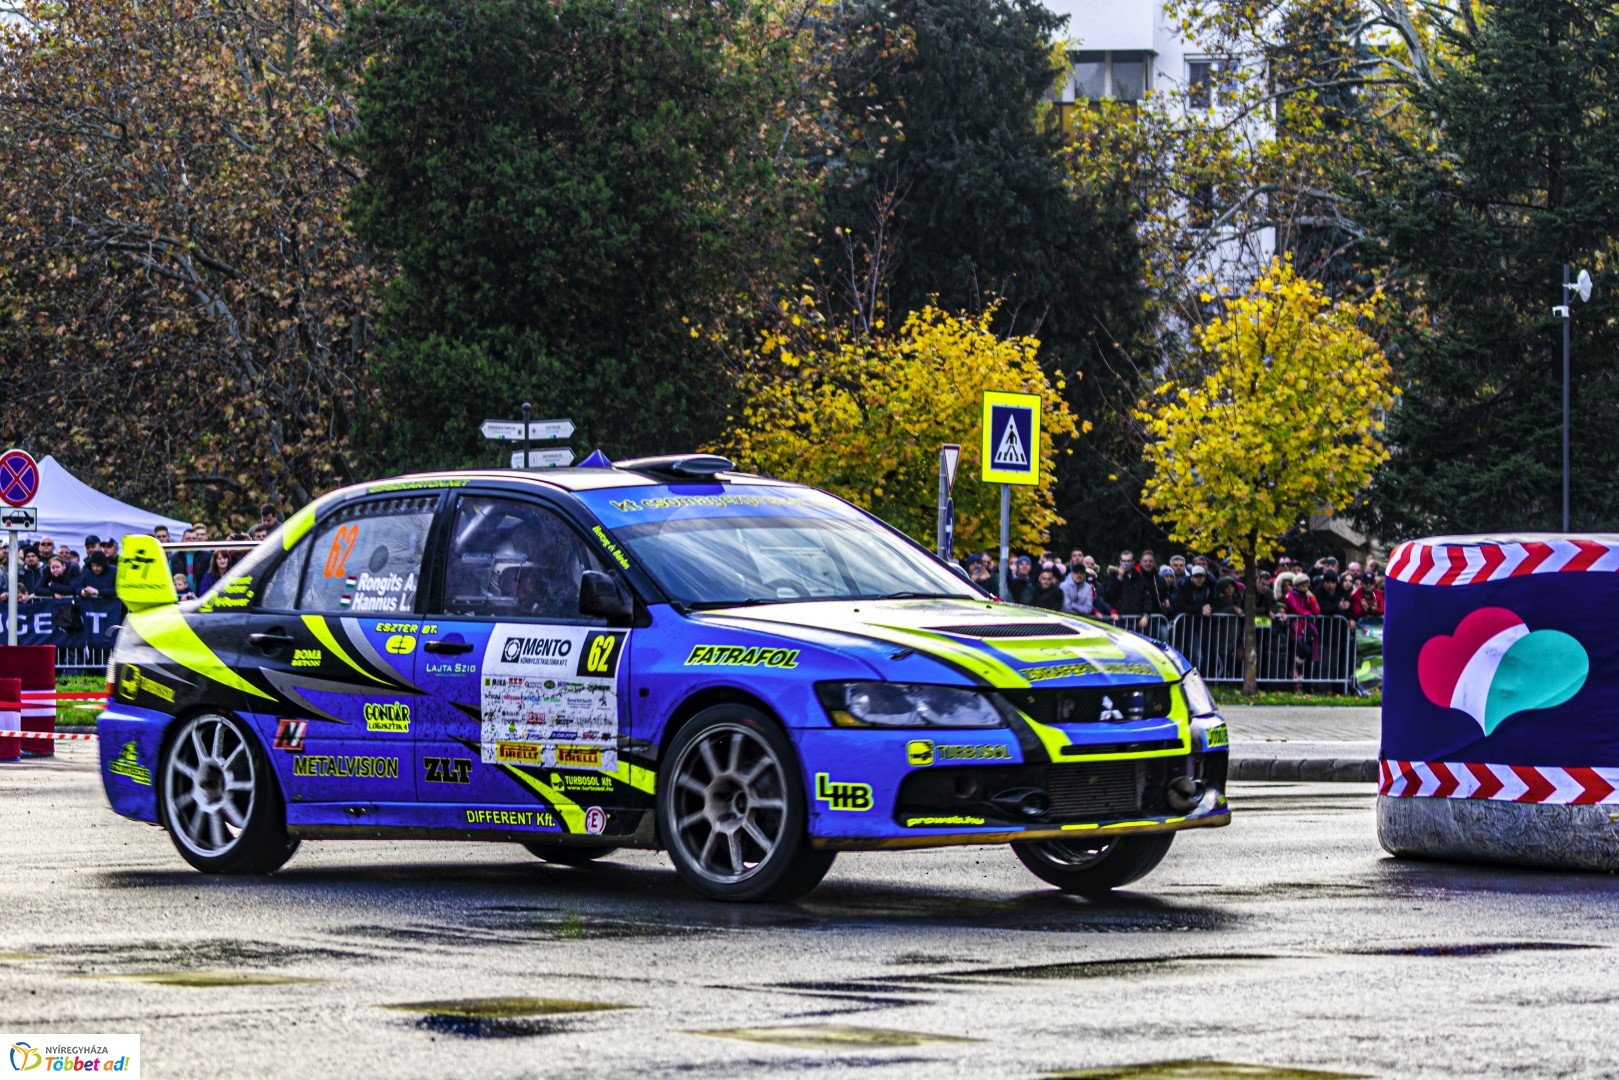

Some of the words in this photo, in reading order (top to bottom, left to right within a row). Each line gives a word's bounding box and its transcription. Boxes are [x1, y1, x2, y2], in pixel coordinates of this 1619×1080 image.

[322, 523, 360, 579] 62
[356, 572, 404, 595] Rongits
[403, 572, 417, 591] A.
[351, 591, 398, 611] Hannus
[399, 592, 411, 612] L.
[0, 612, 108, 635] GET
[375, 622, 418, 634] ESZTER
[421, 623, 439, 635] BT.
[586, 634, 616, 673] 62
[685, 645, 799, 668] FATRAFOL
[425, 663, 452, 674] LAJTA
[454, 663, 477, 674] SZIG
[364, 701, 411, 722] GONDÁR
[499, 743, 539, 760] PIRELLI
[557, 748, 599, 764] PIRELLI
[936, 744, 1012, 760] TURBOSOL
[293, 755, 399, 779] METALVISION
[423, 757, 473, 784] ZLT
[564, 775, 600, 787] TURBOSOL
[466, 809, 533, 826] DIFFERENT
[536, 812, 557, 827] Kft.
[590, 811, 598, 828] E
